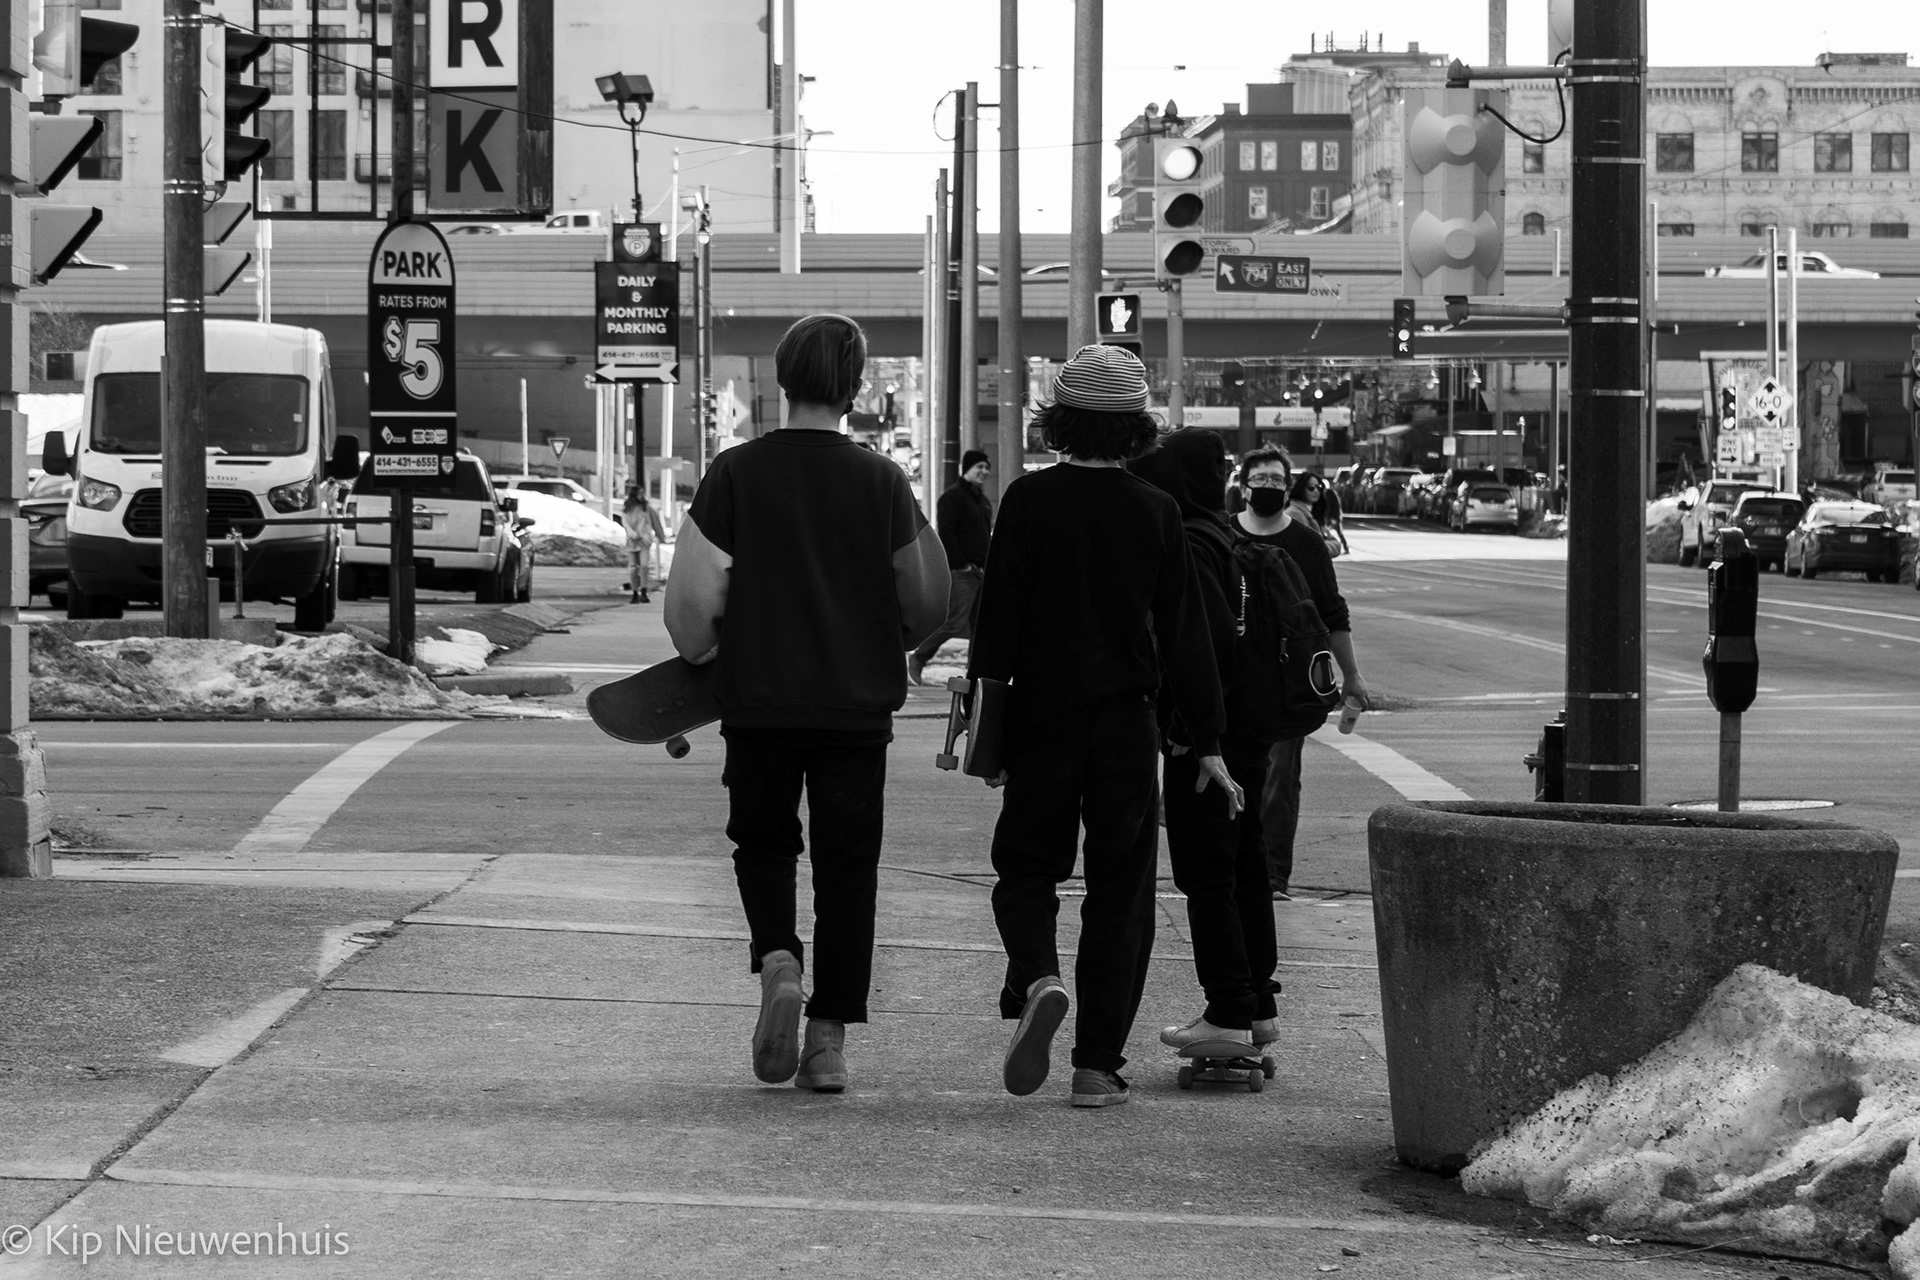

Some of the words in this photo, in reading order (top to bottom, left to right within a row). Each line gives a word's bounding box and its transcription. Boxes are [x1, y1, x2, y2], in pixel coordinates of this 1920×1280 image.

[383, 250, 442, 278] PARK
[1245, 267, 1268, 283] 794
[1277, 263, 1305, 275] EAST
[617, 275, 656, 287] DAILY
[1276, 277, 1305, 288] ONLY
[631, 291, 643, 303] &
[1310, 288, 1339, 297] OWN
[379, 295, 414, 308] RATES
[416, 296, 447, 309] FROM
[604, 307, 669, 318] MONTHLY
[607, 323, 667, 334] PARKING
[383, 317, 443, 399] $5
[1722, 439, 1737, 447] ONE
[376, 457, 438, 467] 414-431-6555
